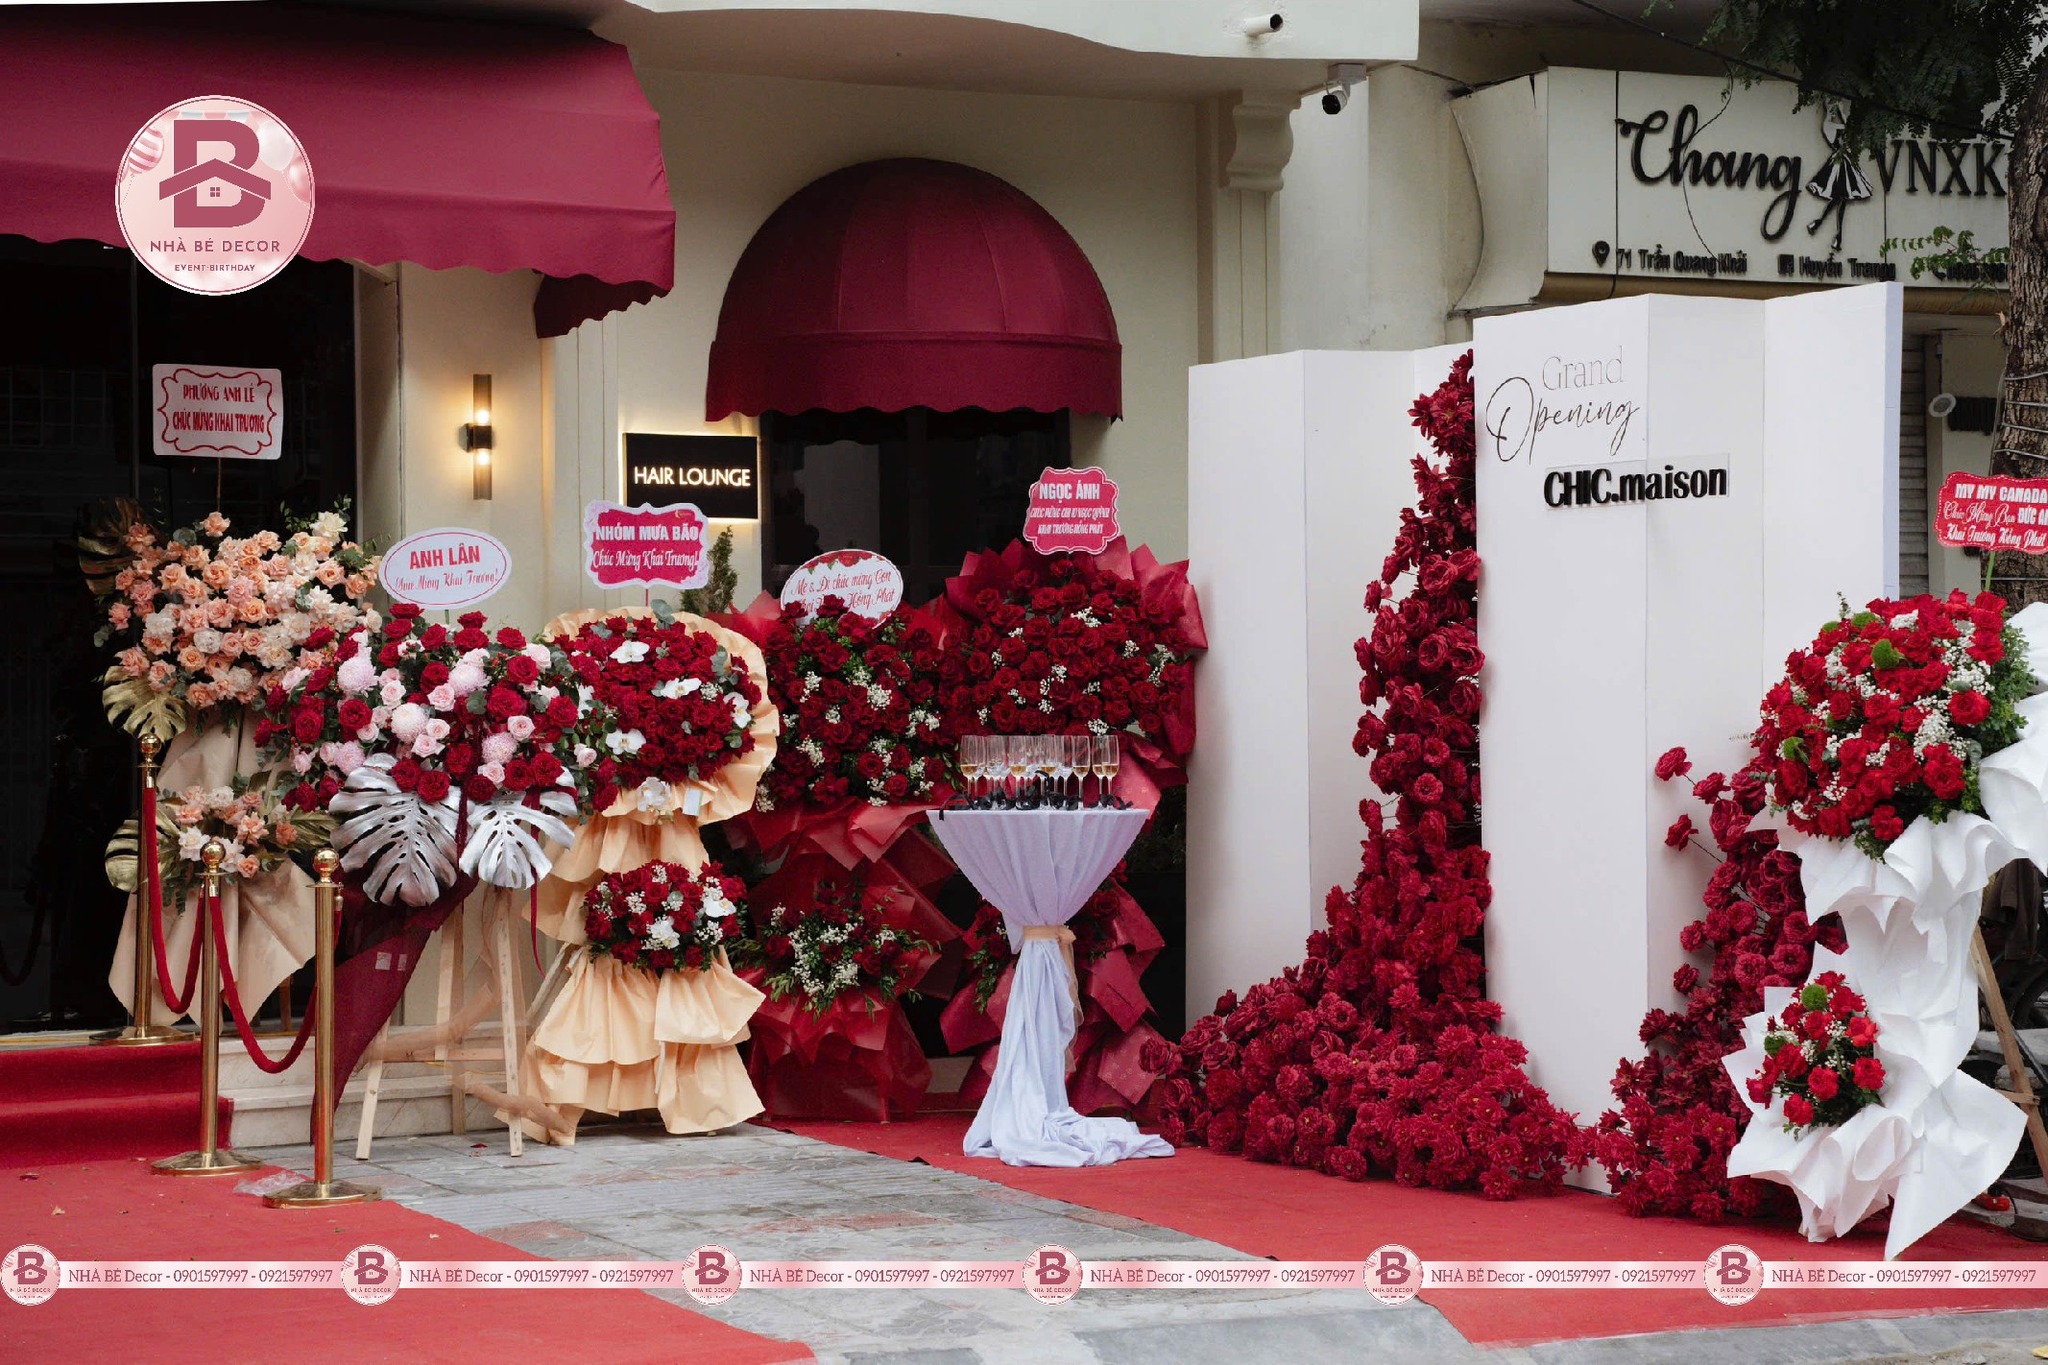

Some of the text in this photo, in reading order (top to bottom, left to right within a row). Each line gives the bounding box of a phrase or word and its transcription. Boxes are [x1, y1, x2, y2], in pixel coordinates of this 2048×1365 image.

[1615, 105, 2007, 241] Chang VNXK
[1617, 249, 1632, 269] 71
[1673, 251, 1717, 277] Quang
[1542, 345, 1624, 391] Grand
[223, 386, 242, 402] ANH
[215, 413, 234, 432] KHAI
[1486, 377, 1641, 465] Opening
[634, 466, 751, 487] HAIR LOUNGE
[1039, 483, 1073, 504] NGỌC
[1955, 483, 2047, 504] MY MY CANADA
[596, 522, 699, 541] NHÓM MƯA BÃO
[410, 542, 481, 570] ANH LÂN
[642, 548, 665, 569] Khai
